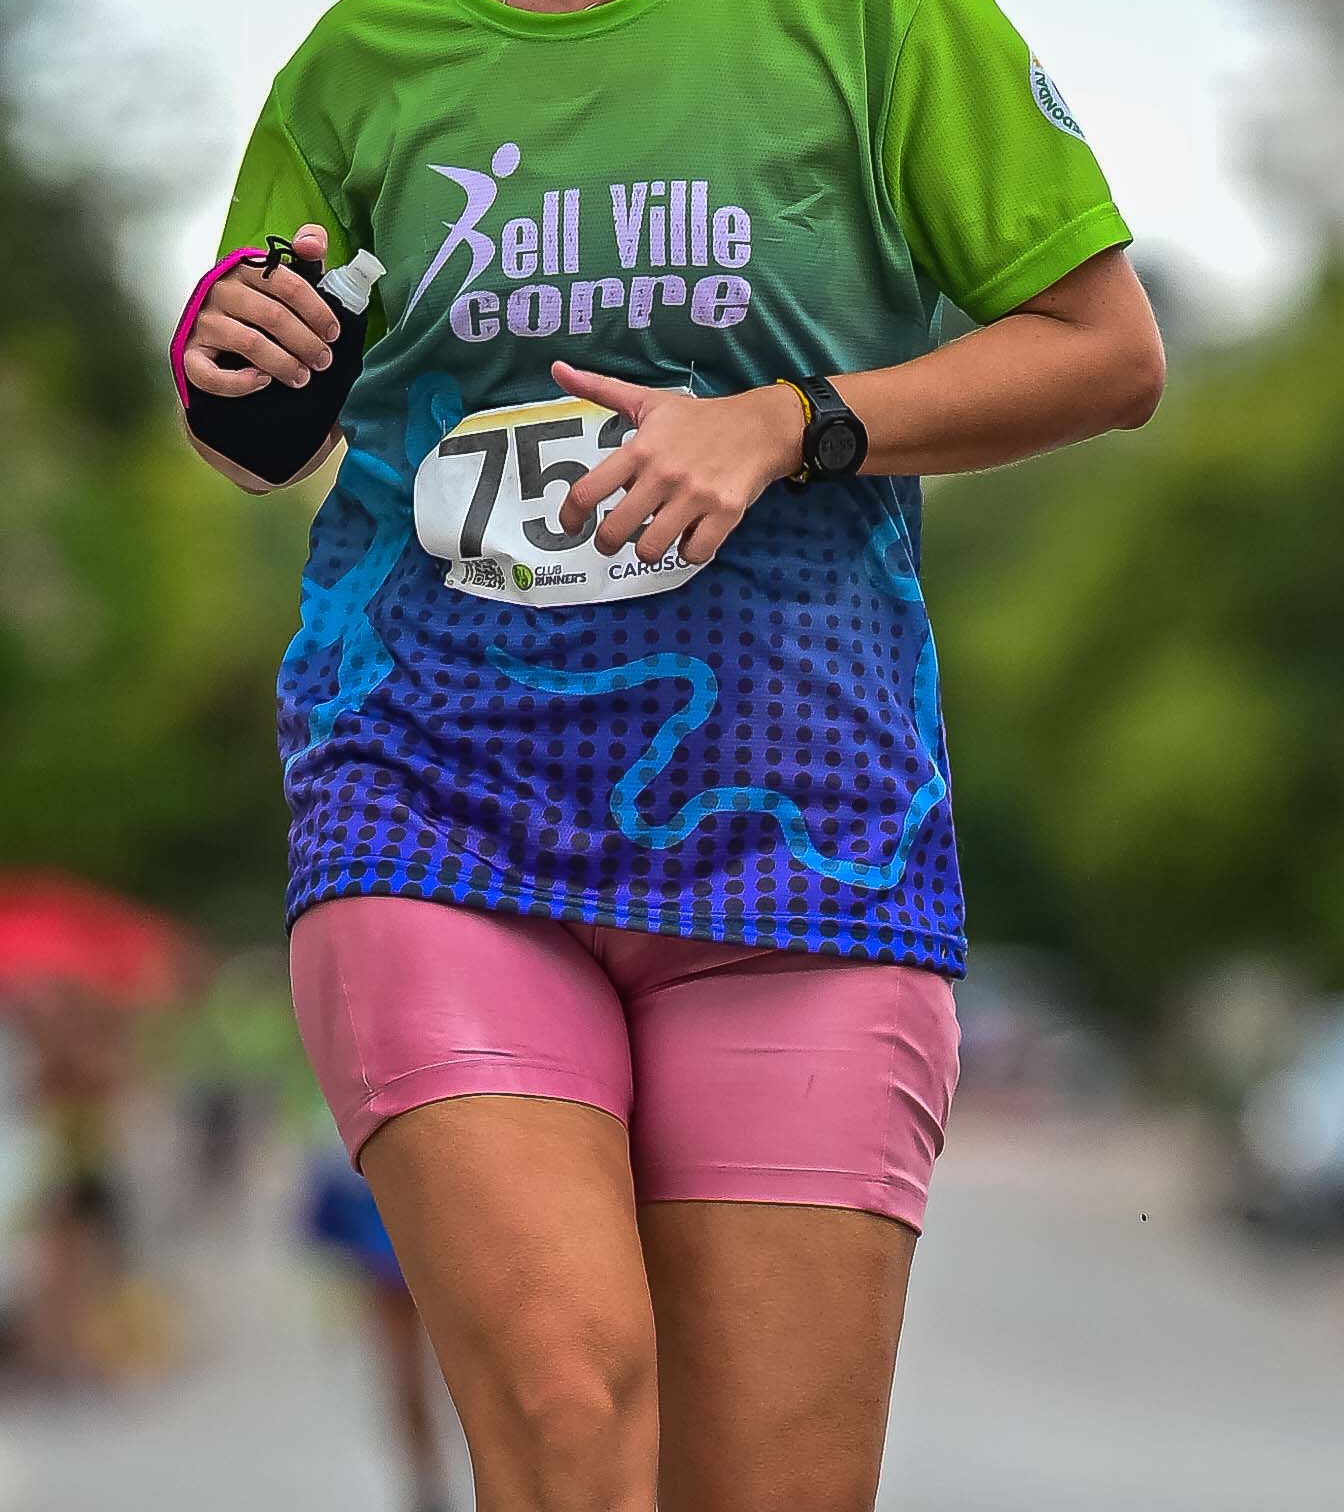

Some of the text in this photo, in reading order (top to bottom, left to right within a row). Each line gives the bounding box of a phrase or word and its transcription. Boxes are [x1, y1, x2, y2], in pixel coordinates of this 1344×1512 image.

[610, 180, 752, 268] Ville
[450, 274, 752, 342] corre
[438, 416, 646, 558] 75
[534, 564, 562, 576] CLUB
